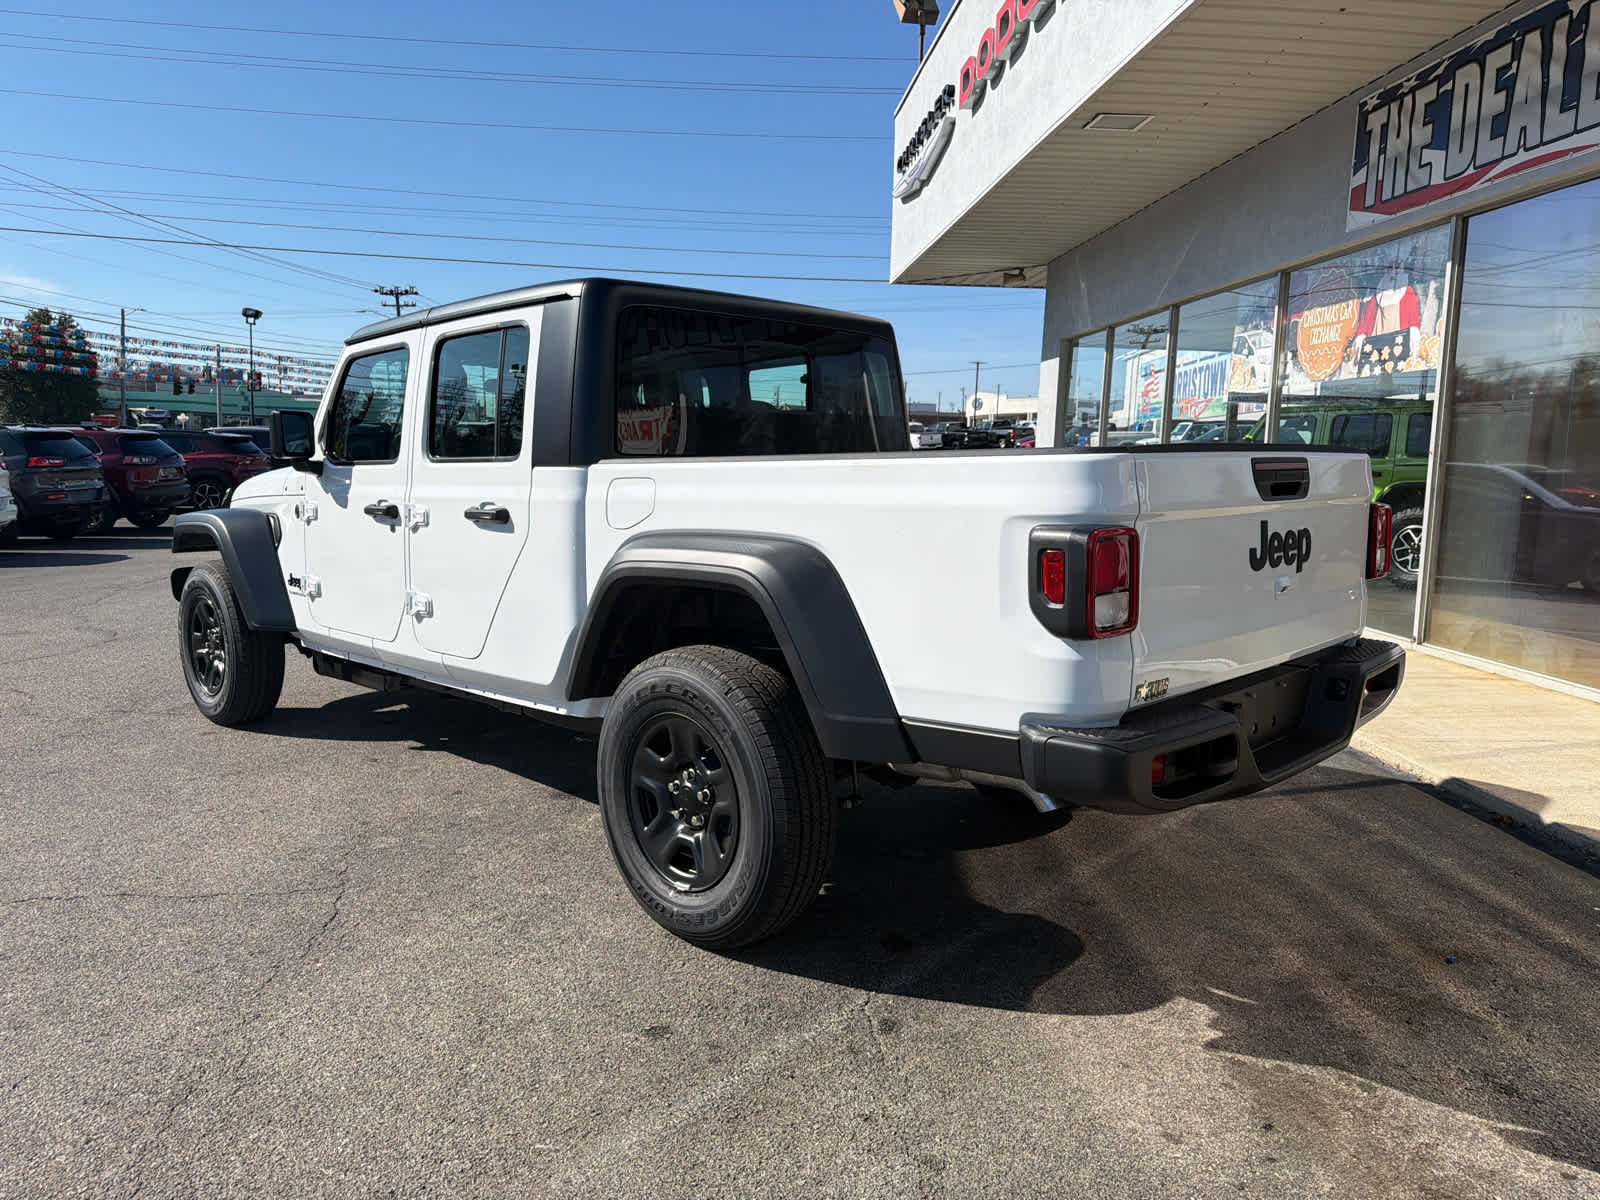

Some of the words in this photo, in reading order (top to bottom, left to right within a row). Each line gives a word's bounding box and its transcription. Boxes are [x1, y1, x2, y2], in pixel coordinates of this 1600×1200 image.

[1364, 79, 1440, 209] THE
[1303, 303, 1339, 328] CHRISTMAS
[1340, 300, 1354, 320] CAR
[1310, 323, 1343, 346] EXCHANGE
[1174, 359, 1227, 405] RRISTOWN
[1249, 519, 1312, 574] Jeep
